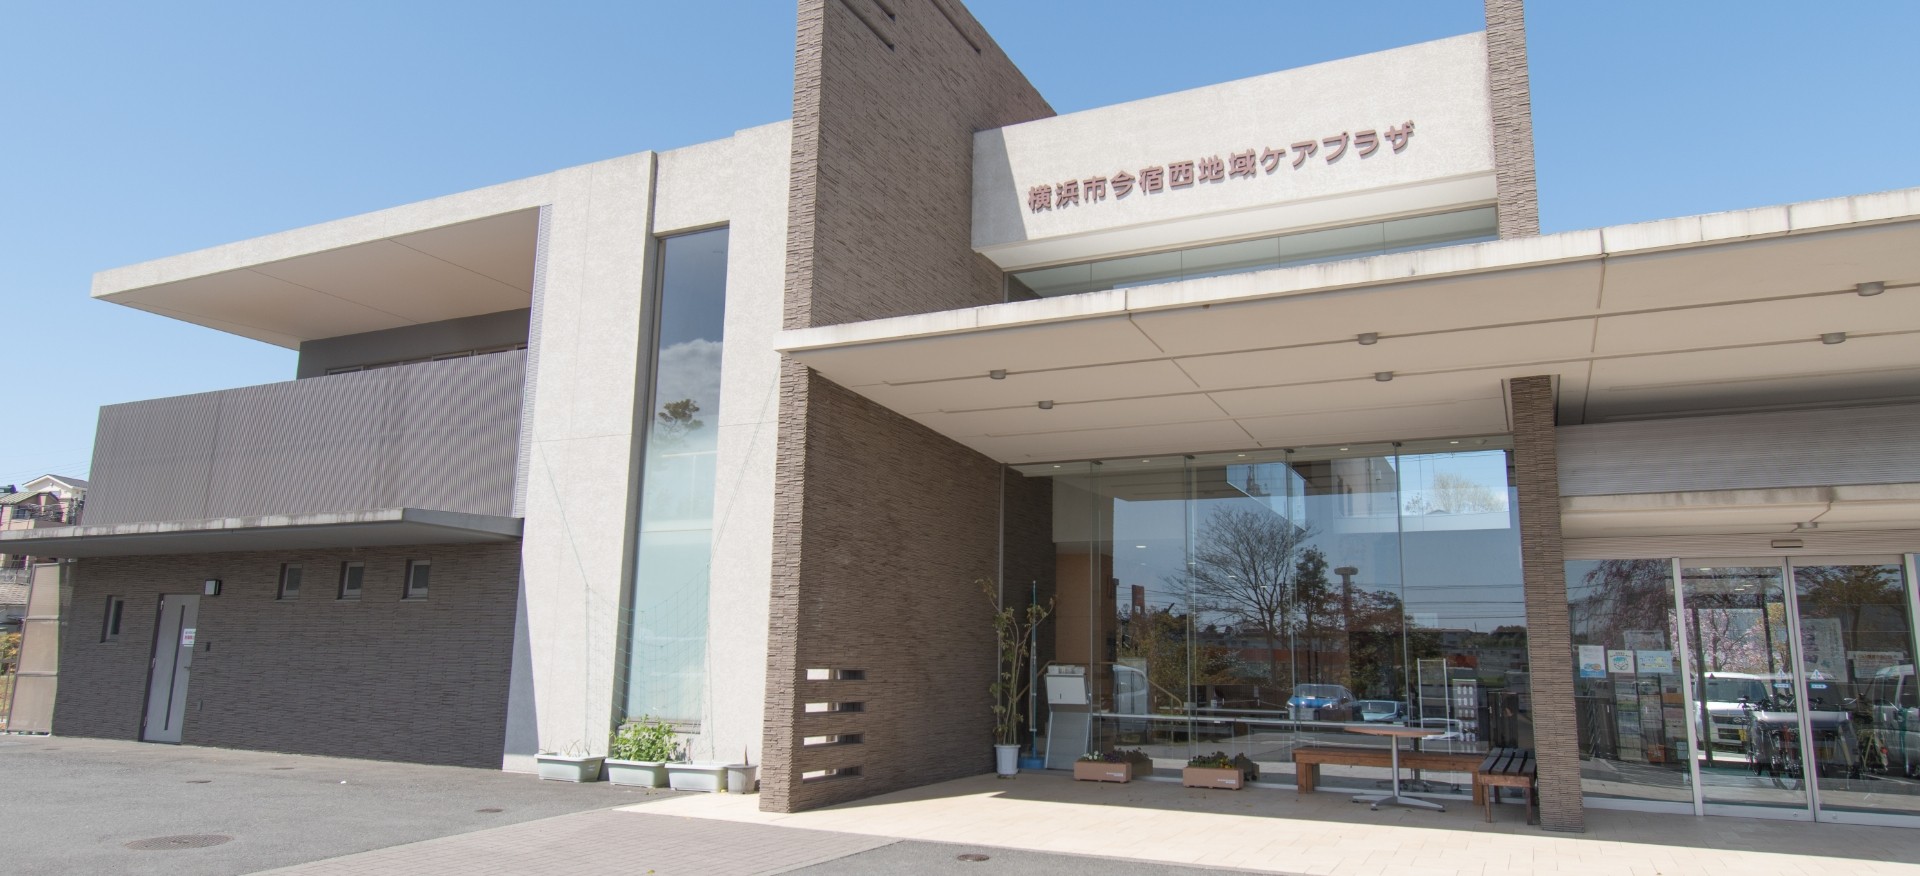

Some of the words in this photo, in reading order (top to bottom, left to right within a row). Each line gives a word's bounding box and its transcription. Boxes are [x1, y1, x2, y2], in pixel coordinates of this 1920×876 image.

[1028, 119, 1416, 213] 横浜市今宿西地域ケアプラザ
